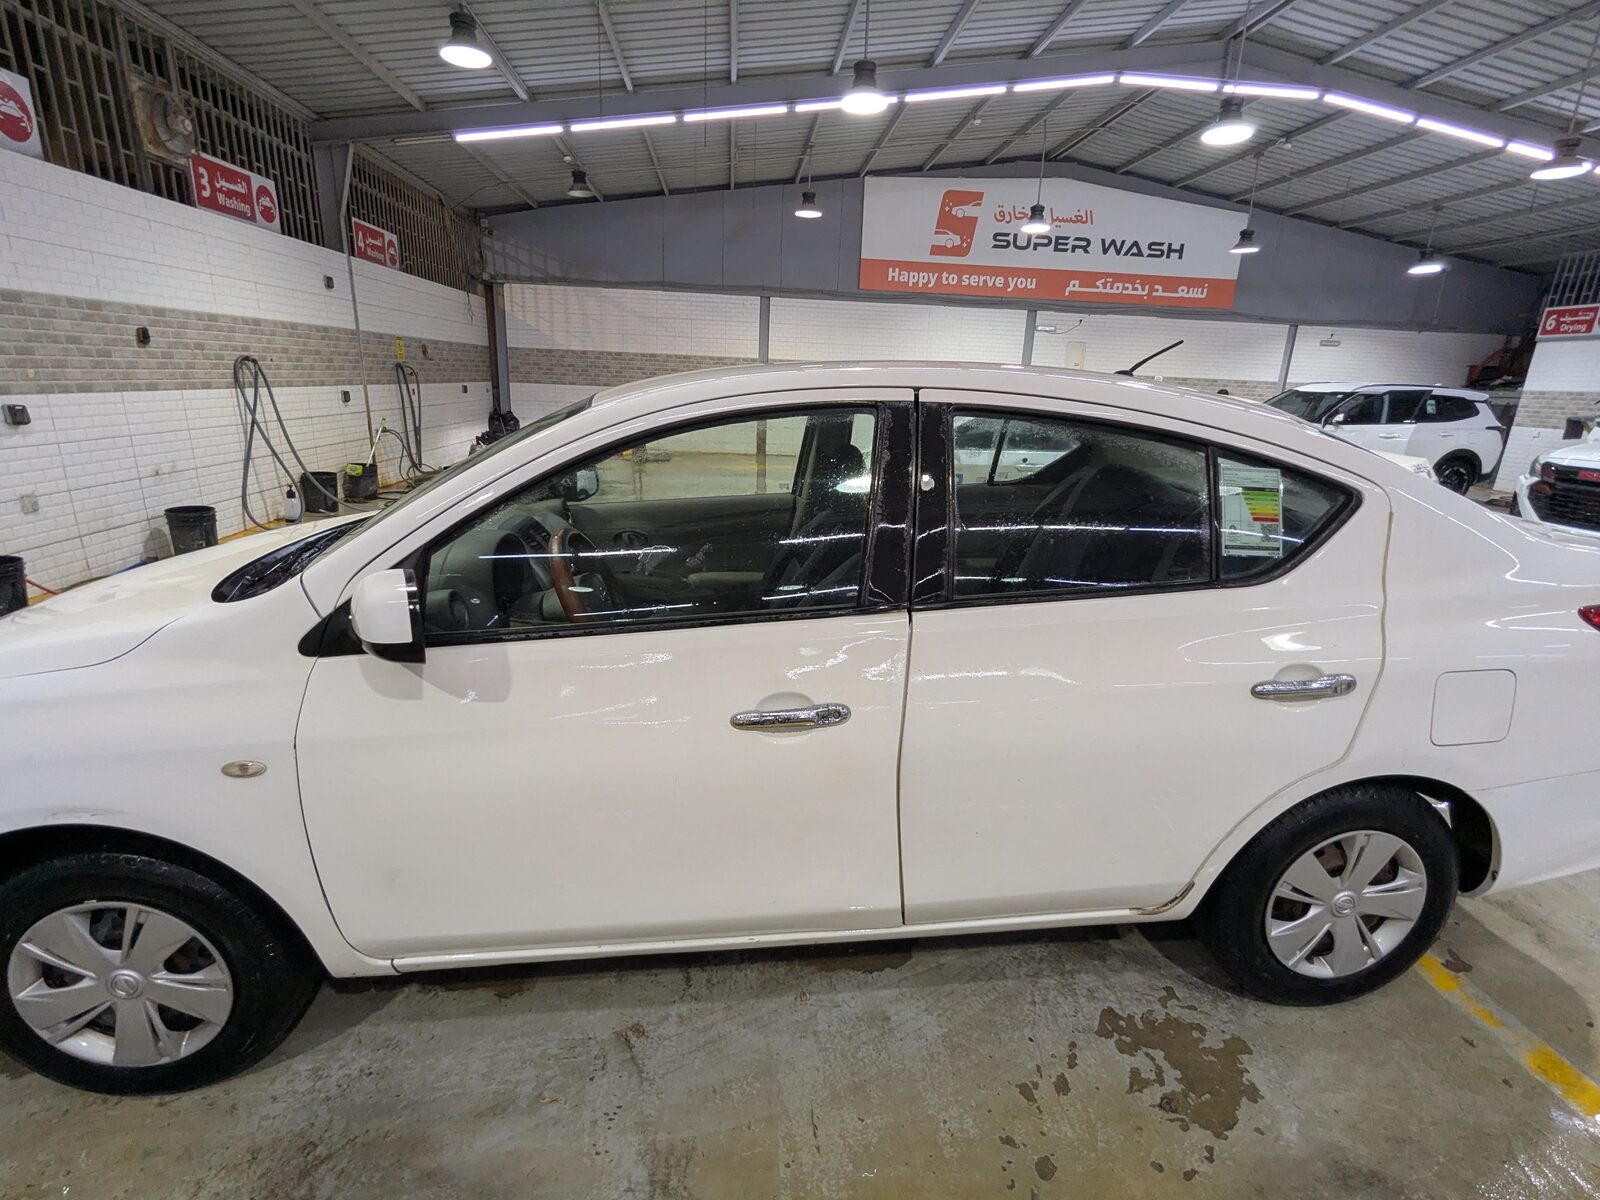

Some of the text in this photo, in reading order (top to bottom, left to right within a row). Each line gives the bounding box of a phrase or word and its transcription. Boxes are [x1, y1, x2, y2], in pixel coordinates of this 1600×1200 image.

[198, 166, 211, 198] 3
[215, 171, 248, 194] الغسيل
[216, 192, 251, 217] Washing
[993, 204, 1094, 230] الغسيل خارق
[358, 230, 365, 252] 4
[991, 232, 1185, 260] SUPER WASH
[888, 267, 1037, 290] Happy to serve you
[1546, 314, 1557, 331] 6
[1560, 323, 1588, 333] Drying
